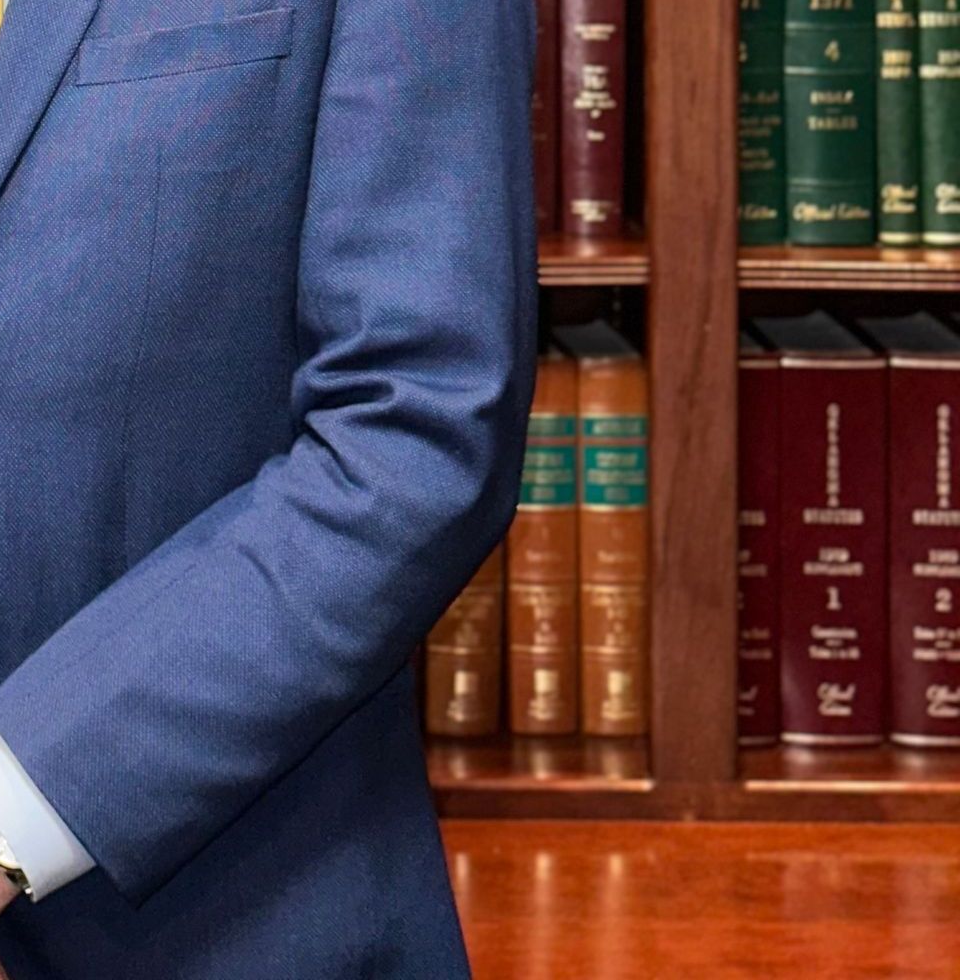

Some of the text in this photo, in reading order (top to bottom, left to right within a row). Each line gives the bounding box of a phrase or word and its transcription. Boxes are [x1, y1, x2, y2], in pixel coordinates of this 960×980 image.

[824, 40, 840, 62] 4
[826, 586, 841, 610] 1
[934, 587, 953, 612] 2
